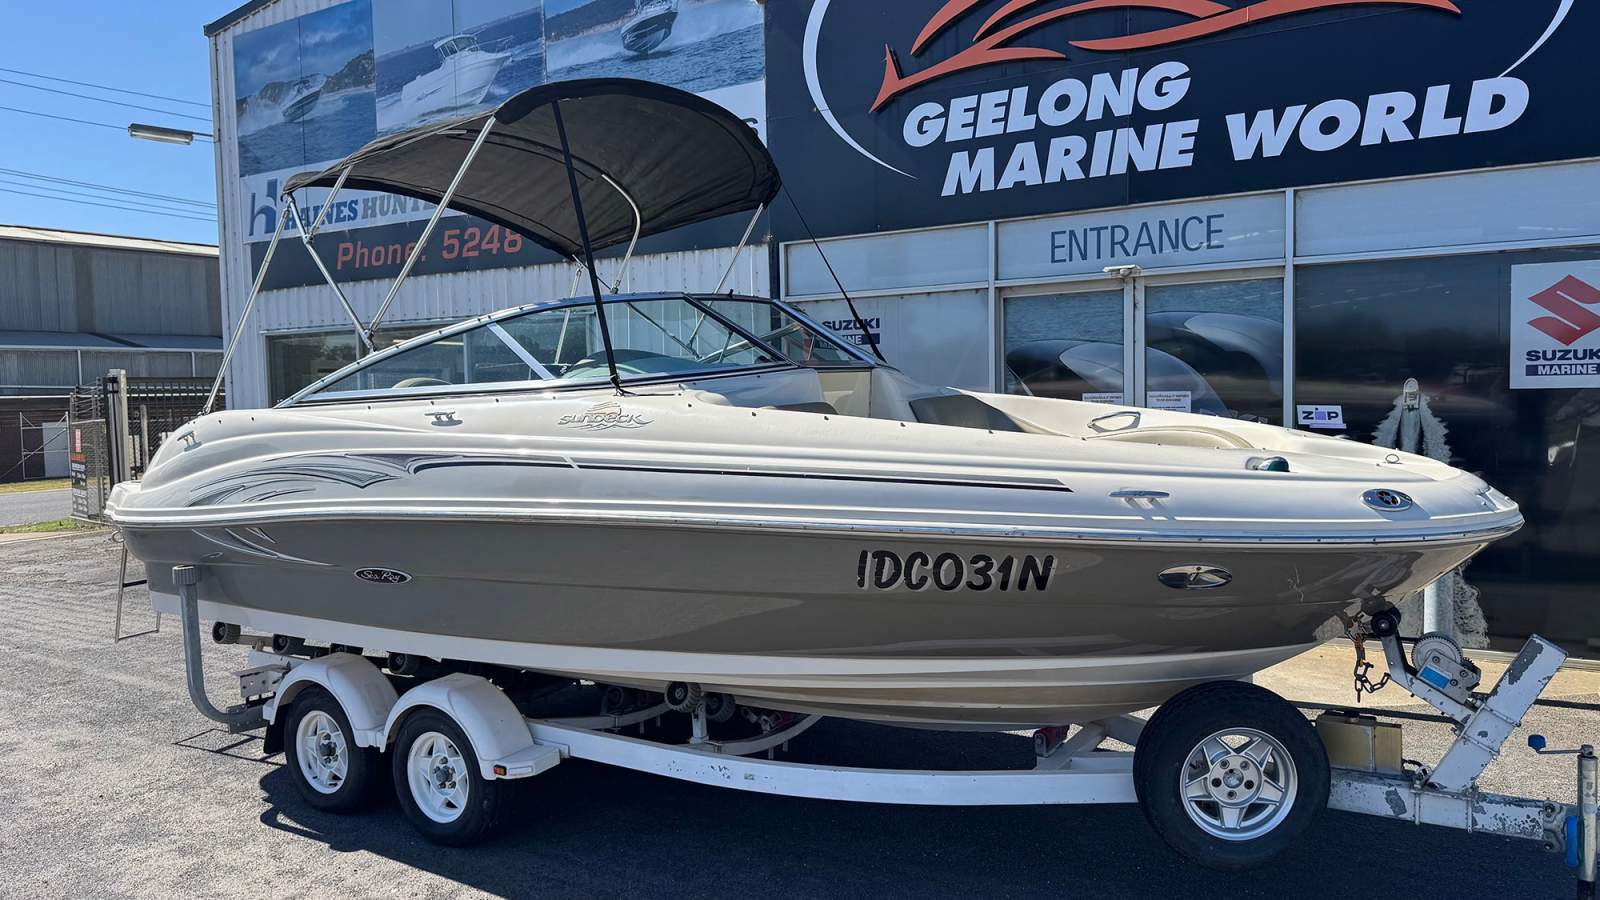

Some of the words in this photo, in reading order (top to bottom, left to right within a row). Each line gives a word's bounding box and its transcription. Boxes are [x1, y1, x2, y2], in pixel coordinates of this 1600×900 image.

[903, 61, 1191, 147] GEELONG
[941, 119, 1199, 196] MARINE
[1225, 77, 1529, 161] WORLD
[442, 224, 522, 259] 5248
[1050, 213, 1225, 263] ENTRANCE
[1538, 364, 1598, 375] MARINE
